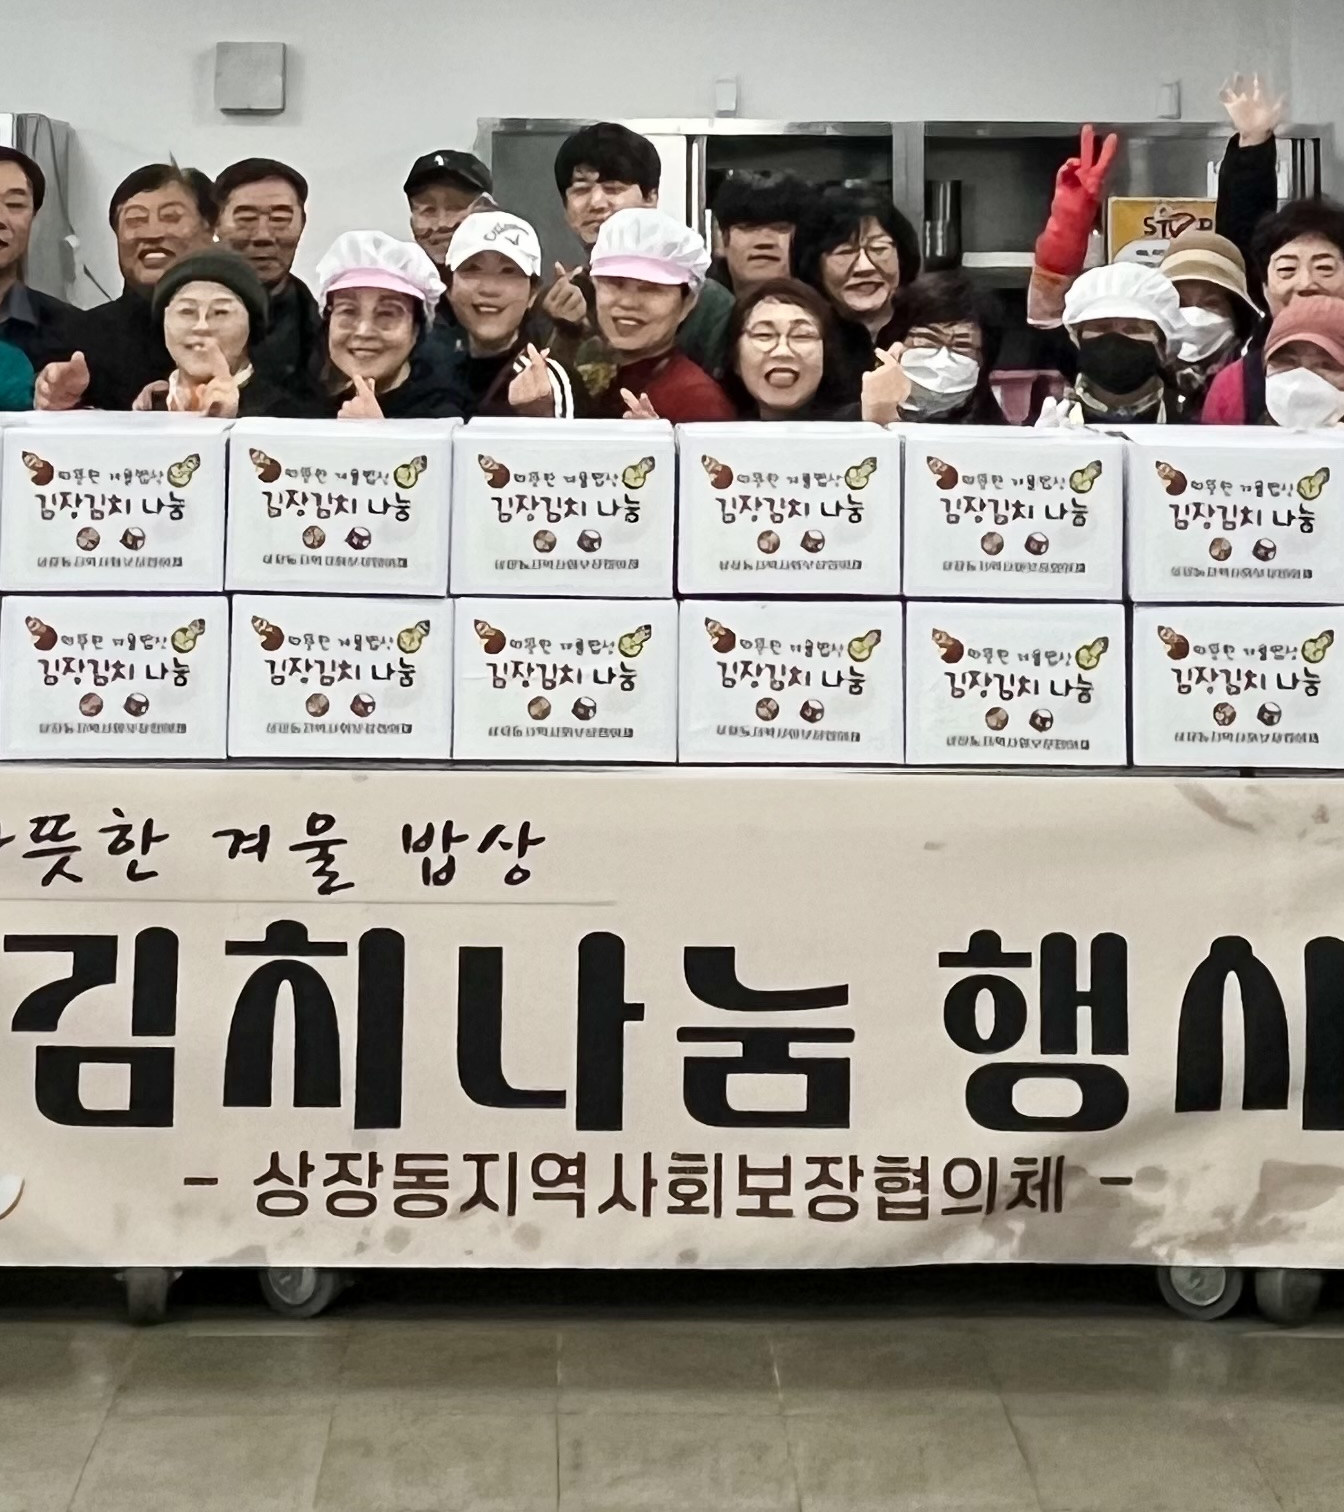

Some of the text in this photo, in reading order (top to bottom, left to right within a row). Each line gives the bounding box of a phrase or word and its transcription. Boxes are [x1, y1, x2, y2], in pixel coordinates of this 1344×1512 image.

[35, 491, 185, 521] 김장김치 나눔
[262, 489, 411, 522] 김장김치 나눔
[491, 493, 640, 523] 김장김치 나눔
[715, 493, 864, 524] 김장김치 나눔
[940, 496, 1088, 527] 김장김치 나눔
[1169, 502, 1315, 533] 김장김치 나눔
[38, 657, 190, 687] 김장김치 나눔
[264, 657, 416, 687] 김장김치 나눔
[486, 660, 637, 691] 김장김치 나눔
[717, 660, 866, 695] 김장김치 나눔
[944, 670, 1094, 704] 김장김치 나눔
[1171, 666, 1321, 697] 김장김치 나눔
[212, 812, 354, 895] 겨울
[402, 820, 545, 886] 밥상
[4, 920, 855, 1131] 김치나눔
[253, 1151, 1065, 1223] 상장동지역사회보장협의체
